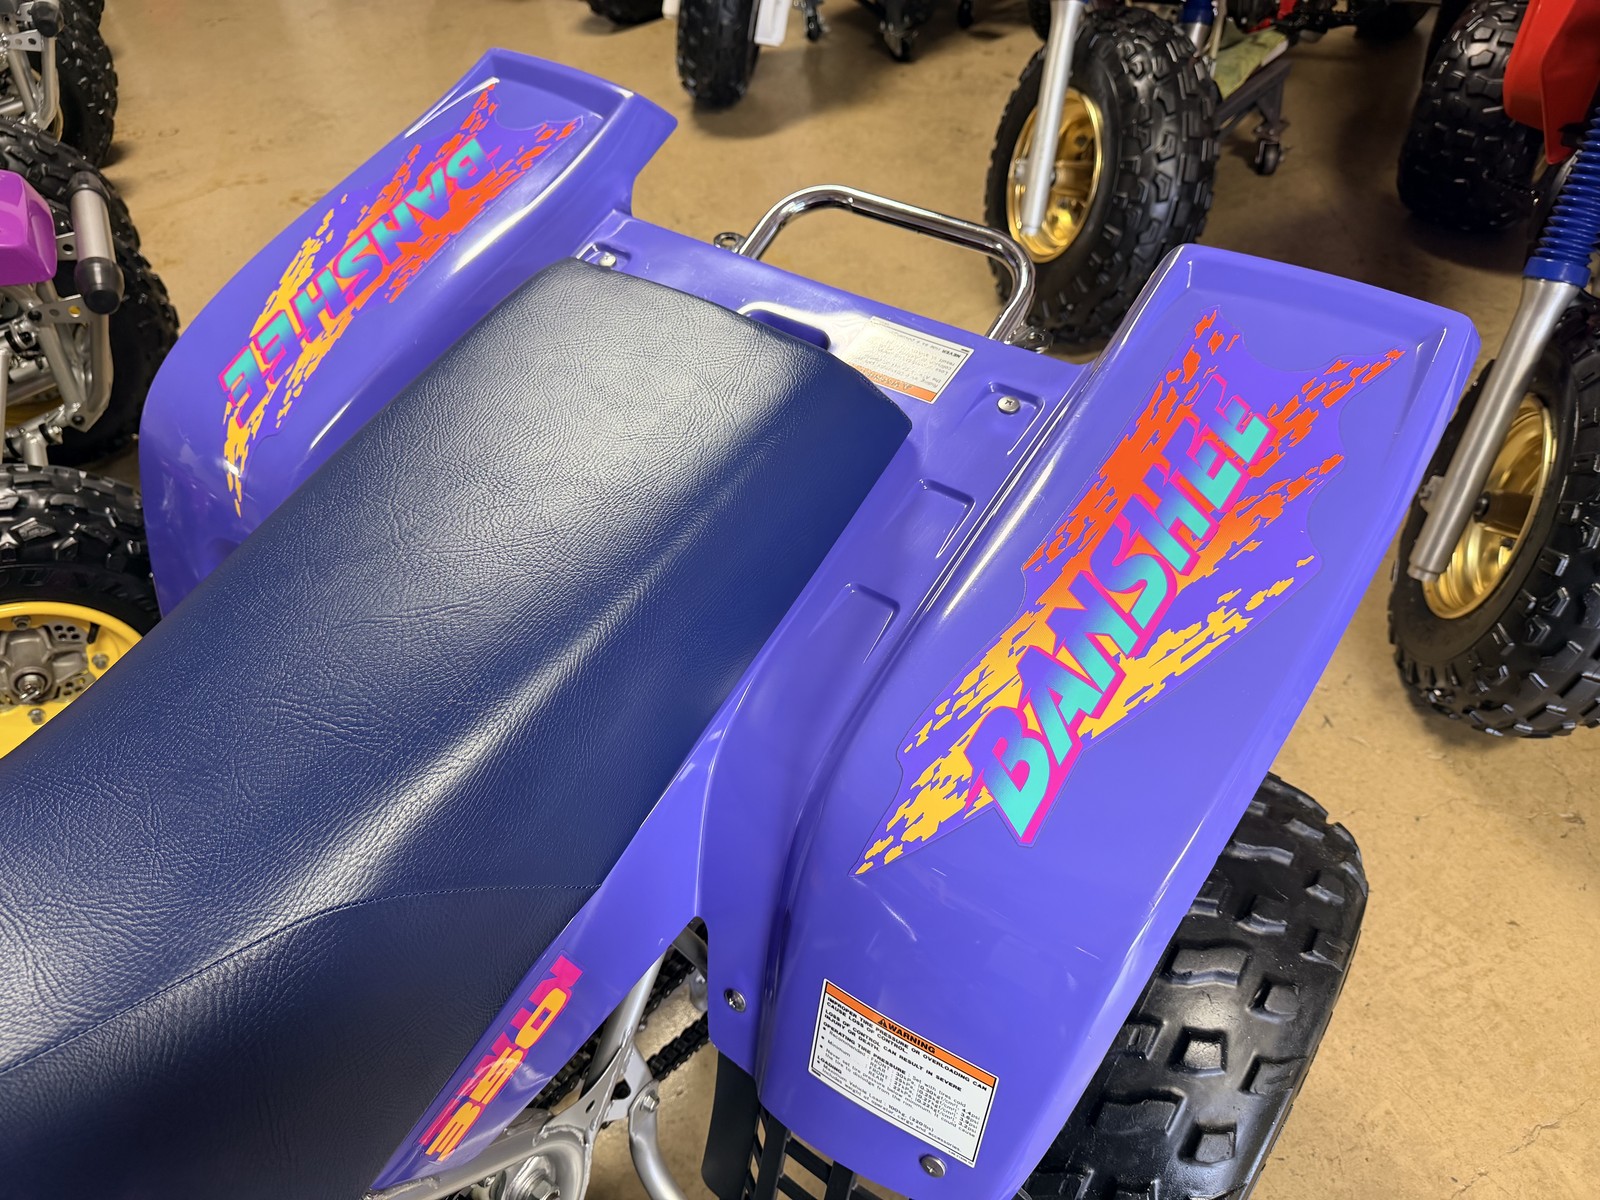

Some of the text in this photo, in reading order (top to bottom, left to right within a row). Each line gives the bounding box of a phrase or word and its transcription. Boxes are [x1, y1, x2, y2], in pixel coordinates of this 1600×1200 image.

[219, 138, 492, 428] BANSHEE
[941, 350, 961, 358] NEVER
[964, 373, 1279, 845] BANSHEE
[824, 1013, 880, 1052] INJURY OR DEATH.
[825, 1008, 962, 1092] LOSS OF CONTROL CAN RESULT IN SEVERE
[826, 1001, 908, 1054] CAUSE LOSS OF CONTROL.
[827, 996, 987, 1091] IMPROPER TIRE PRESSURE OR OVERLOADING CAN
[887, 1024, 936, 1054] WARNING
[425, 988, 573, 1162] 350
[816, 1055, 842, 1074] LOADING
[822, 1021, 855, 1045] OPERATING
[857, 1043, 871, 1055] TIRE
[873, 1052, 906, 1075] PRESSURE
[912, 1075, 922, 1084] Set
[923, 1081, 936, 1092] with
[938, 1089, 951, 1101] tires
[953, 1097, 966, 1108] cold
[822, 1063, 848, 1082] Maximum
[849, 1080, 867, 1094] Vehicle
[868, 1092, 882, 1103] Load
[824, 1052, 833, 1061] the
[834, 1059, 843, 1067] tire
[852, 1070, 874, 1087] dislodge
[876, 1084, 889, 1095] from
[891, 1093, 901, 1101] the
[827, 1039, 851, 1057] Minimum
[868, 1065, 887, 1079] FRONT
[828, 1030, 866, 1057] Recommended
[870, 1056, 889, 1071] FRONT
[961, 1106, 980, 1121] 4.4psi
[868, 1070, 883, 1082] REAR
[869, 1061, 885, 1073] REAR
[821, 1067, 842, 1084] Includes
[844, 1083, 861, 1097] weight
[897, 1114, 913, 1127] cargo
[915, 1123, 926, 1132] and
[927, 1130, 962, 1153] accessories.
[825, 1047, 840, 1060] Never
[851, 1065, 860, 1073] tire
[862, 1072, 885, 1088] pressure
[886, 1085, 902, 1098] below
[940, 1115, 956, 1128] could
[958, 1125, 975, 1138] cause
